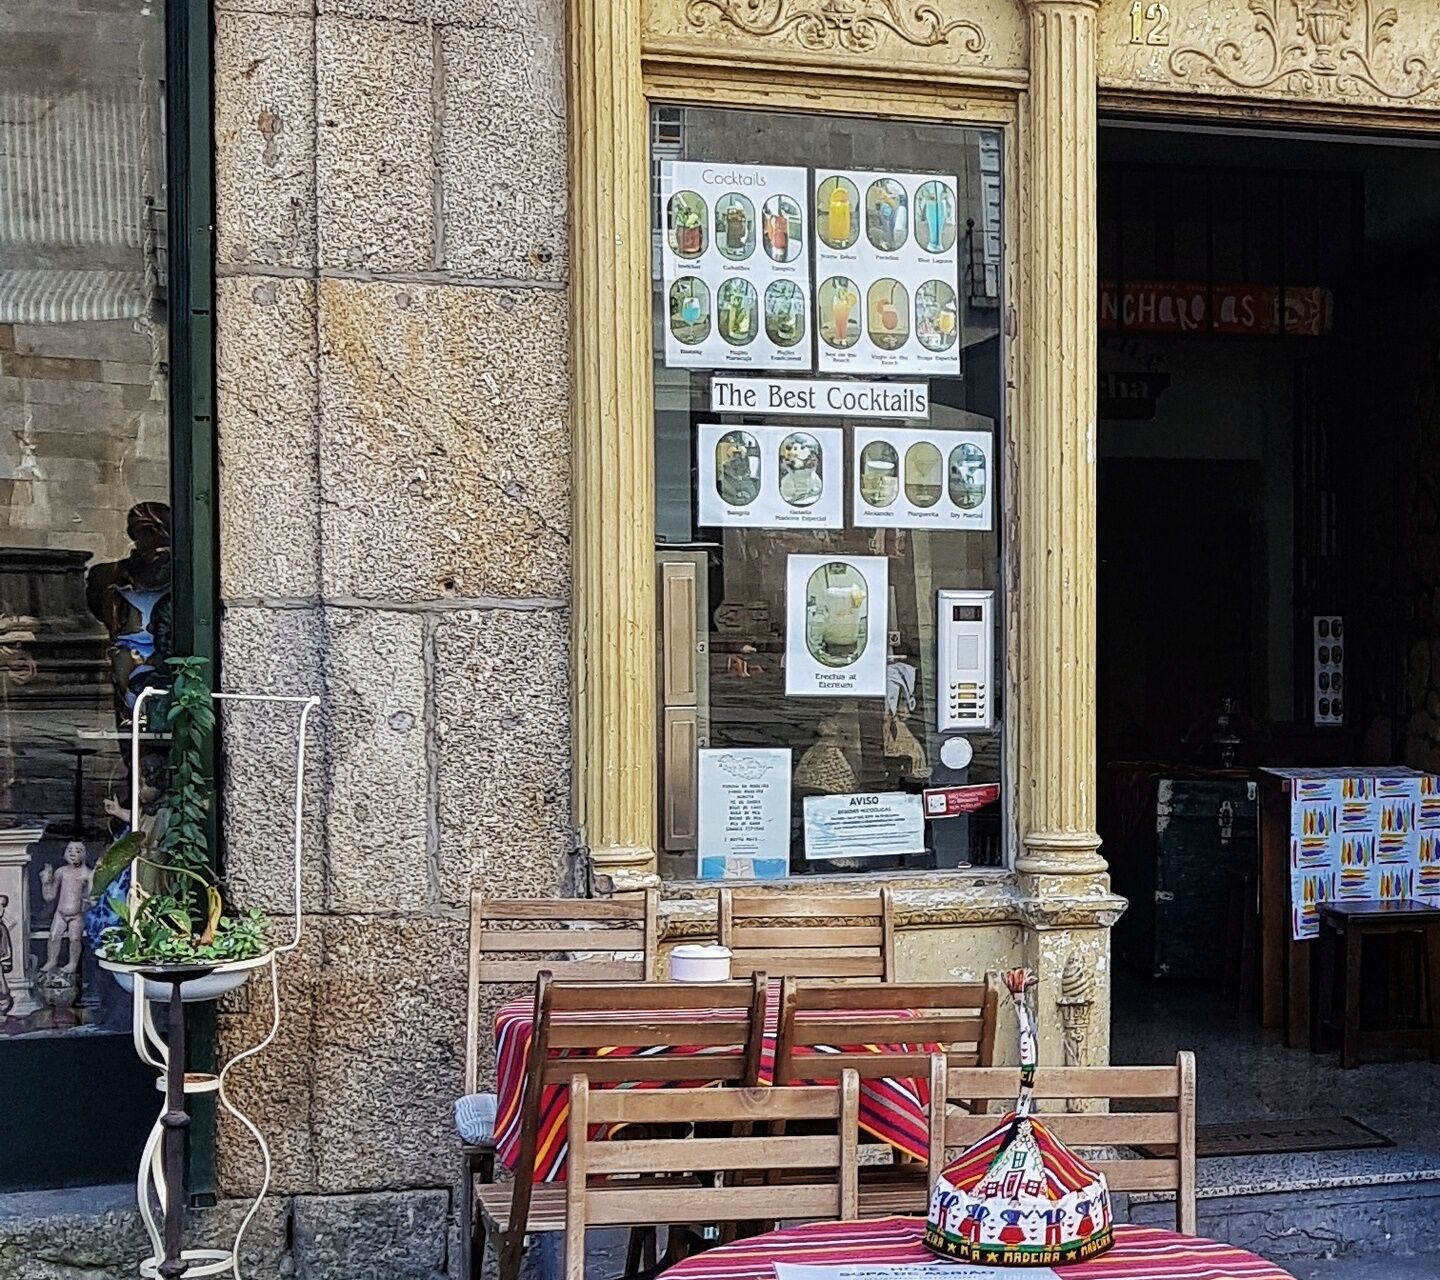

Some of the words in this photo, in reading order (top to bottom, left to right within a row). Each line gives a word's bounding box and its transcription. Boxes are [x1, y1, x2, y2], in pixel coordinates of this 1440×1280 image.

[1129, 1, 1171, 46] 12
[702, 169, 766, 187] Cocktails
[714, 382, 756, 408] The
[768, 384, 816, 410] Best
[827, 386, 926, 413] Cocktails
[850, 796, 879, 806] AVISO
[1003, 1250, 1060, 1264] MADEIRA
